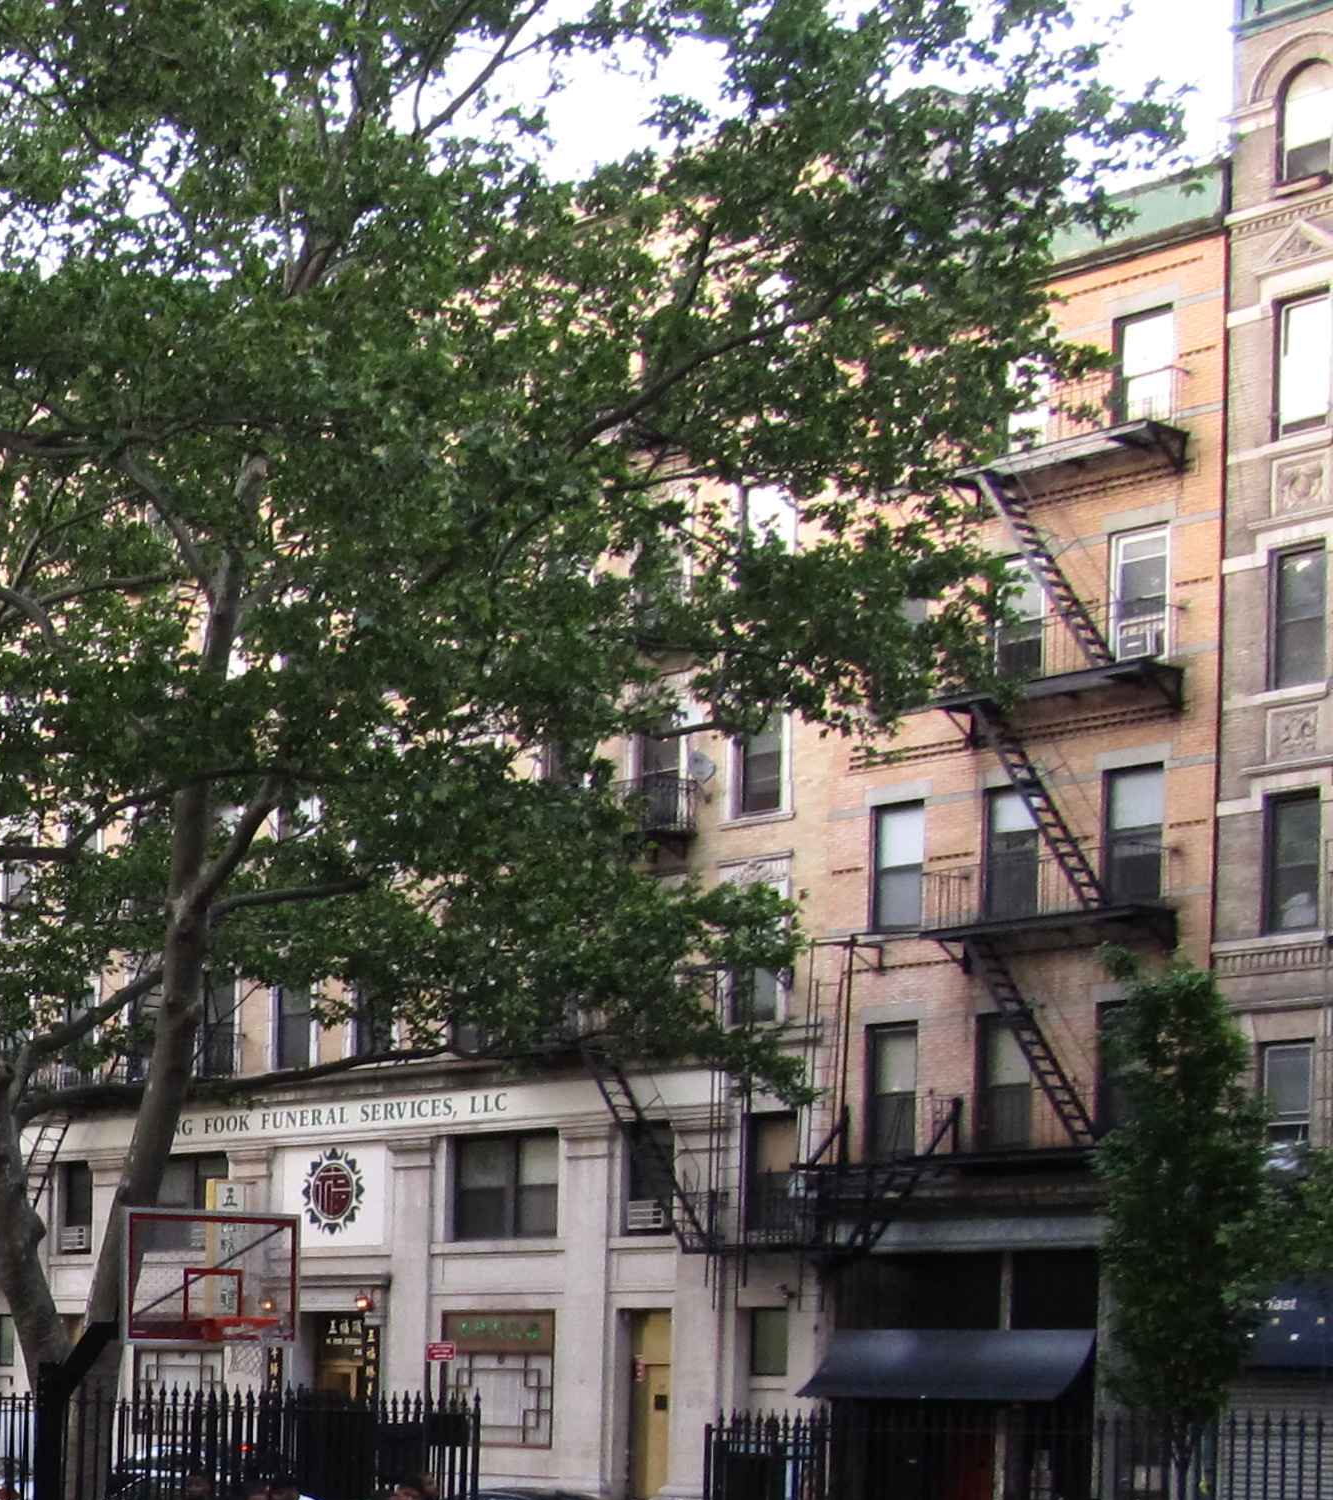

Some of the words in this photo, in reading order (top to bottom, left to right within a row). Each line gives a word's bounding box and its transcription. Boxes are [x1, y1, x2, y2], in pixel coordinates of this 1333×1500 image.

[203, 1113, 250, 1135] FOOK
[261, 1105, 350, 1131] FUNERAL
[360, 1097, 459, 1123] SERVICES,
[470, 1092, 508, 1114] LLC
